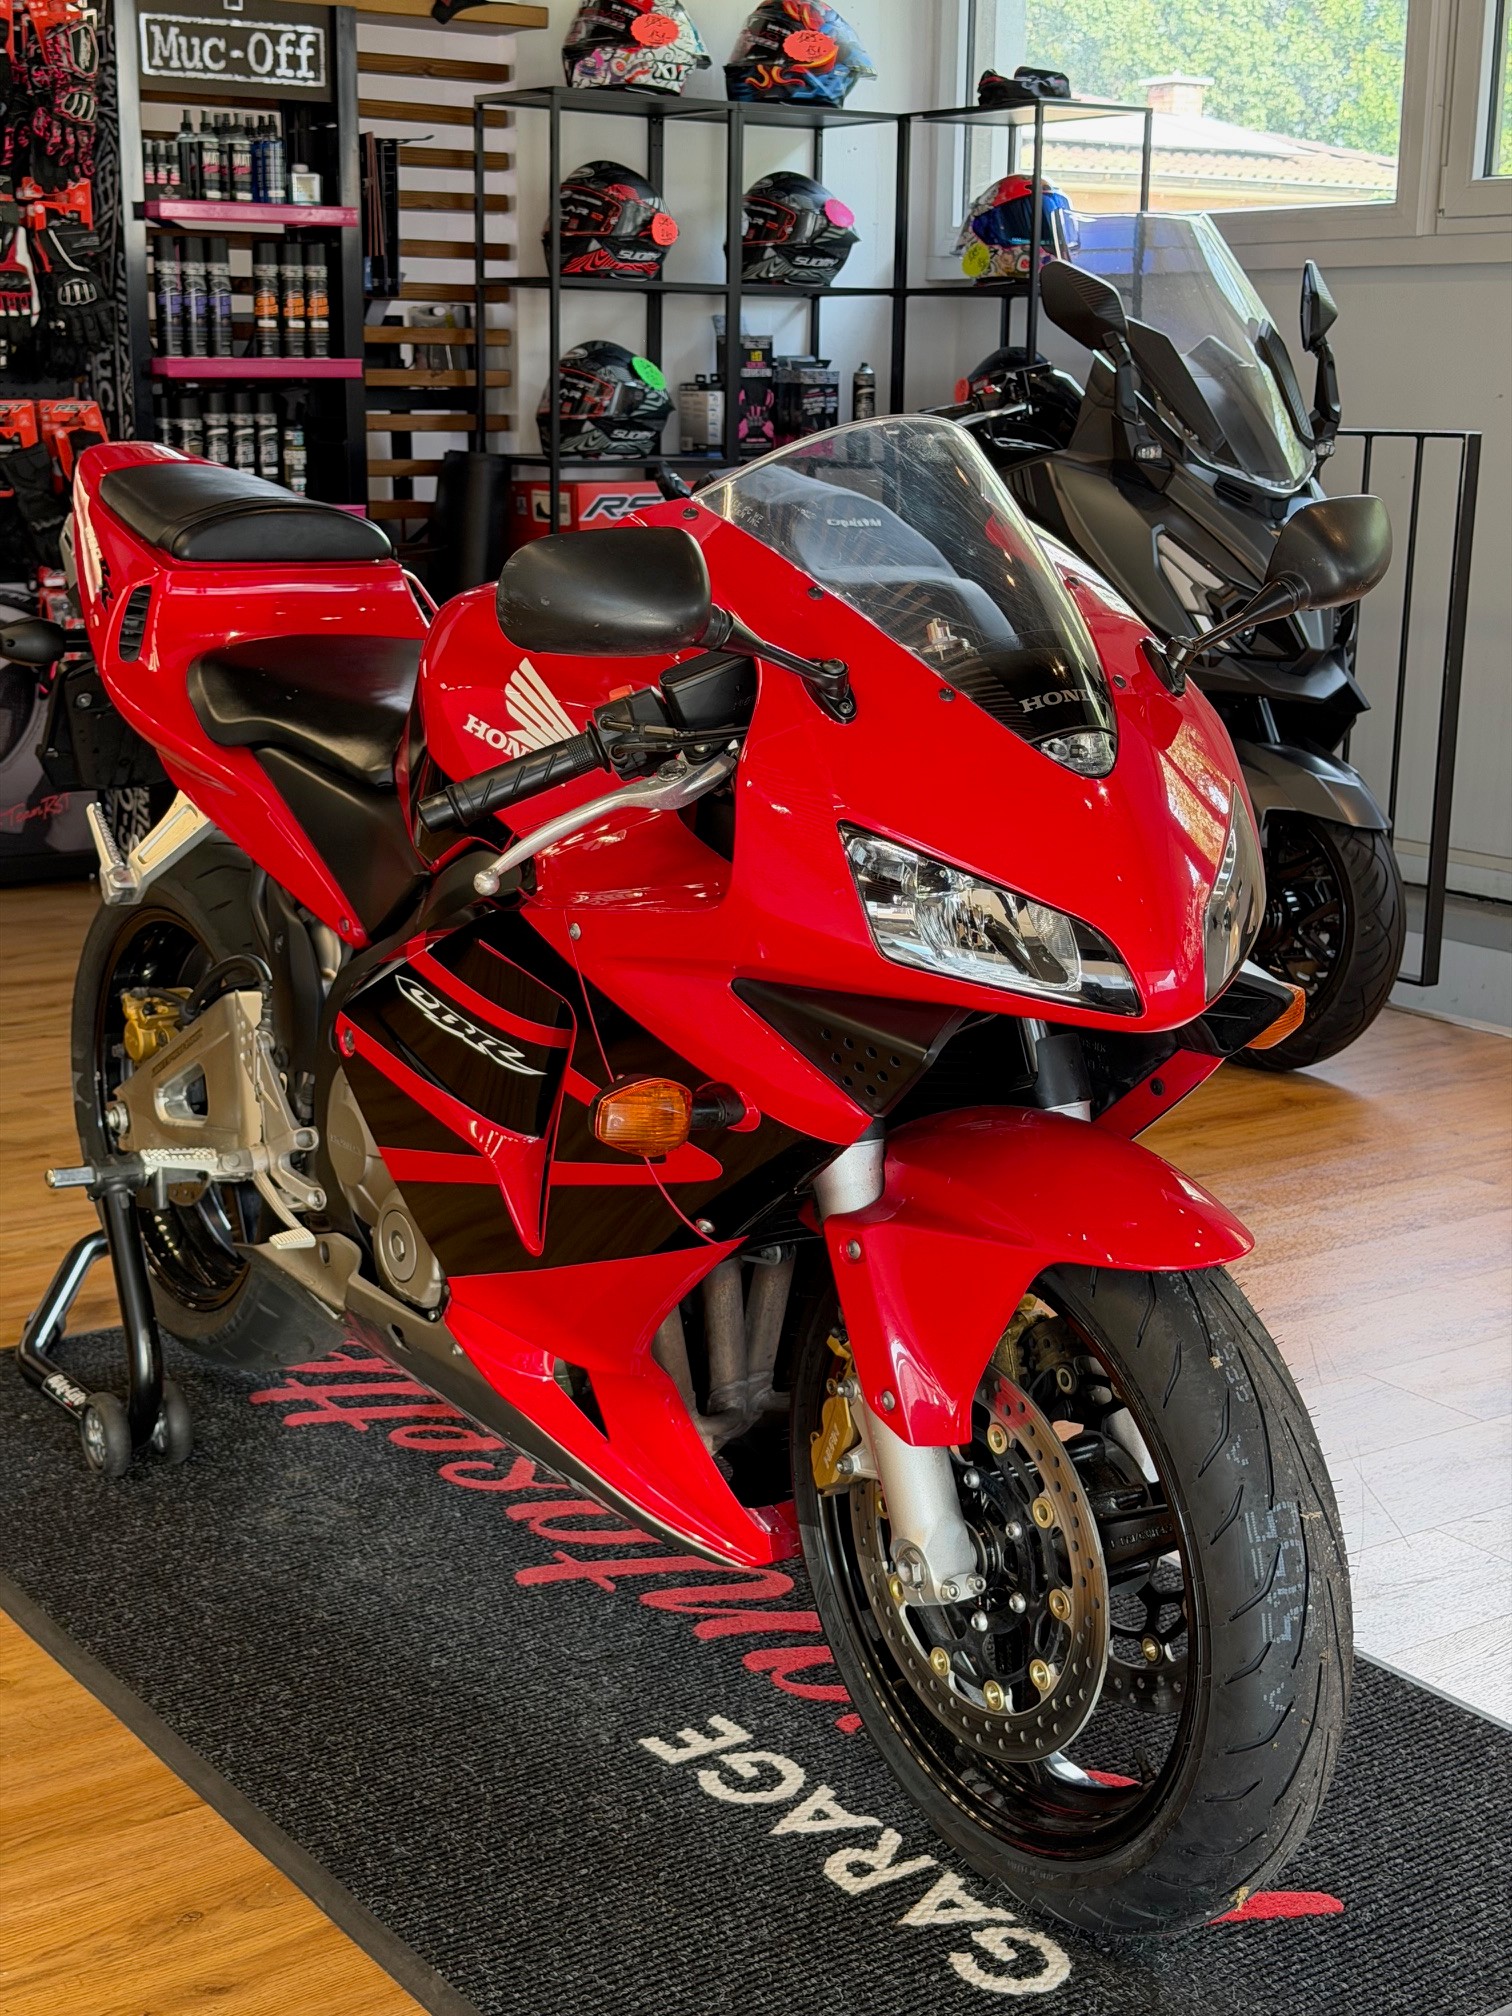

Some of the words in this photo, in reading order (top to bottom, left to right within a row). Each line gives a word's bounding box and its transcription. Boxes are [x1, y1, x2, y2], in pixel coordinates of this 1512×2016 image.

[149, 24, 317, 79] Muc-Off
[0, 403, 30, 413] ST
[579, 492, 666, 521] RS
[462, 713, 534, 759] HON
[638, 1714, 1073, 1996] GARAGE
